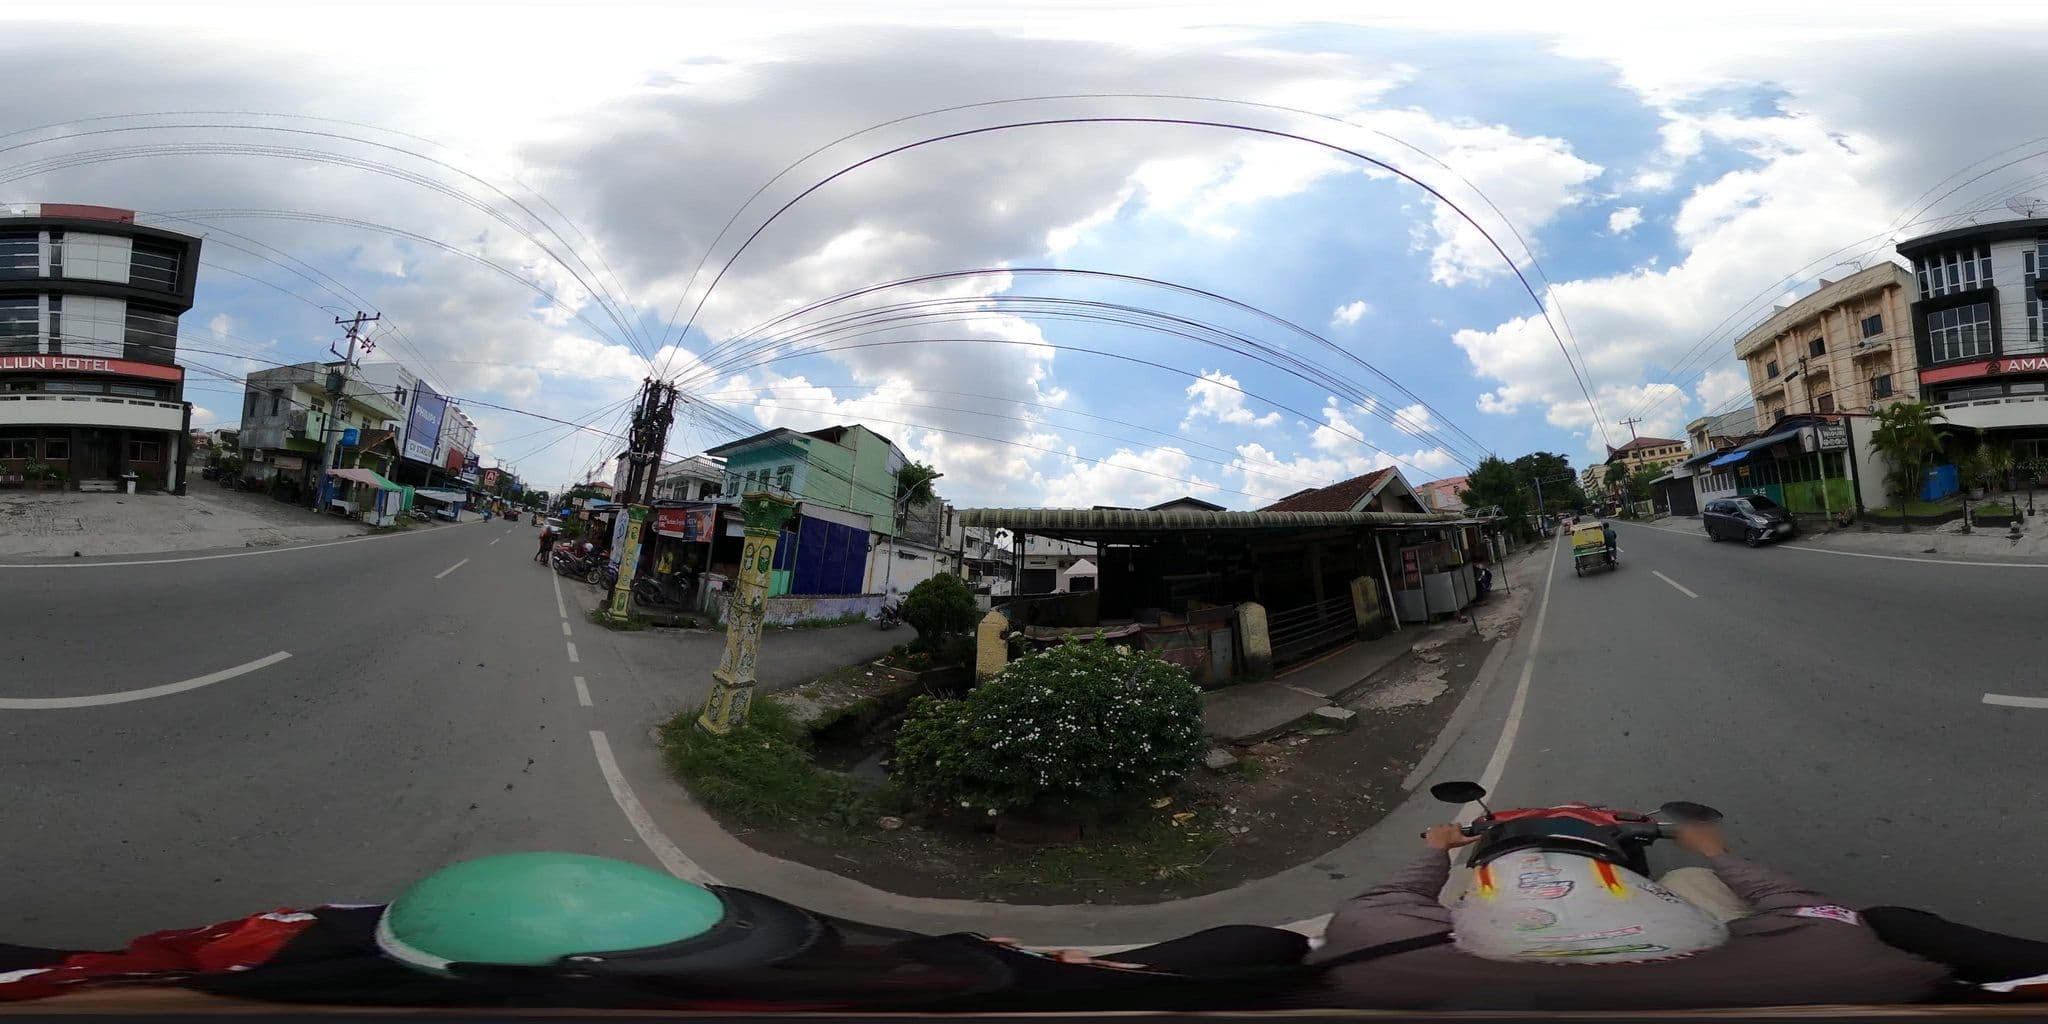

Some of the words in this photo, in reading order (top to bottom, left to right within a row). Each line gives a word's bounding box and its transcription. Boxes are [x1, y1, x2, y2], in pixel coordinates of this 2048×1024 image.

[0, 356, 46, 369] LIUN
[52, 357, 115, 371] HOTEL
[415, 404, 437, 424] PHILIPS
